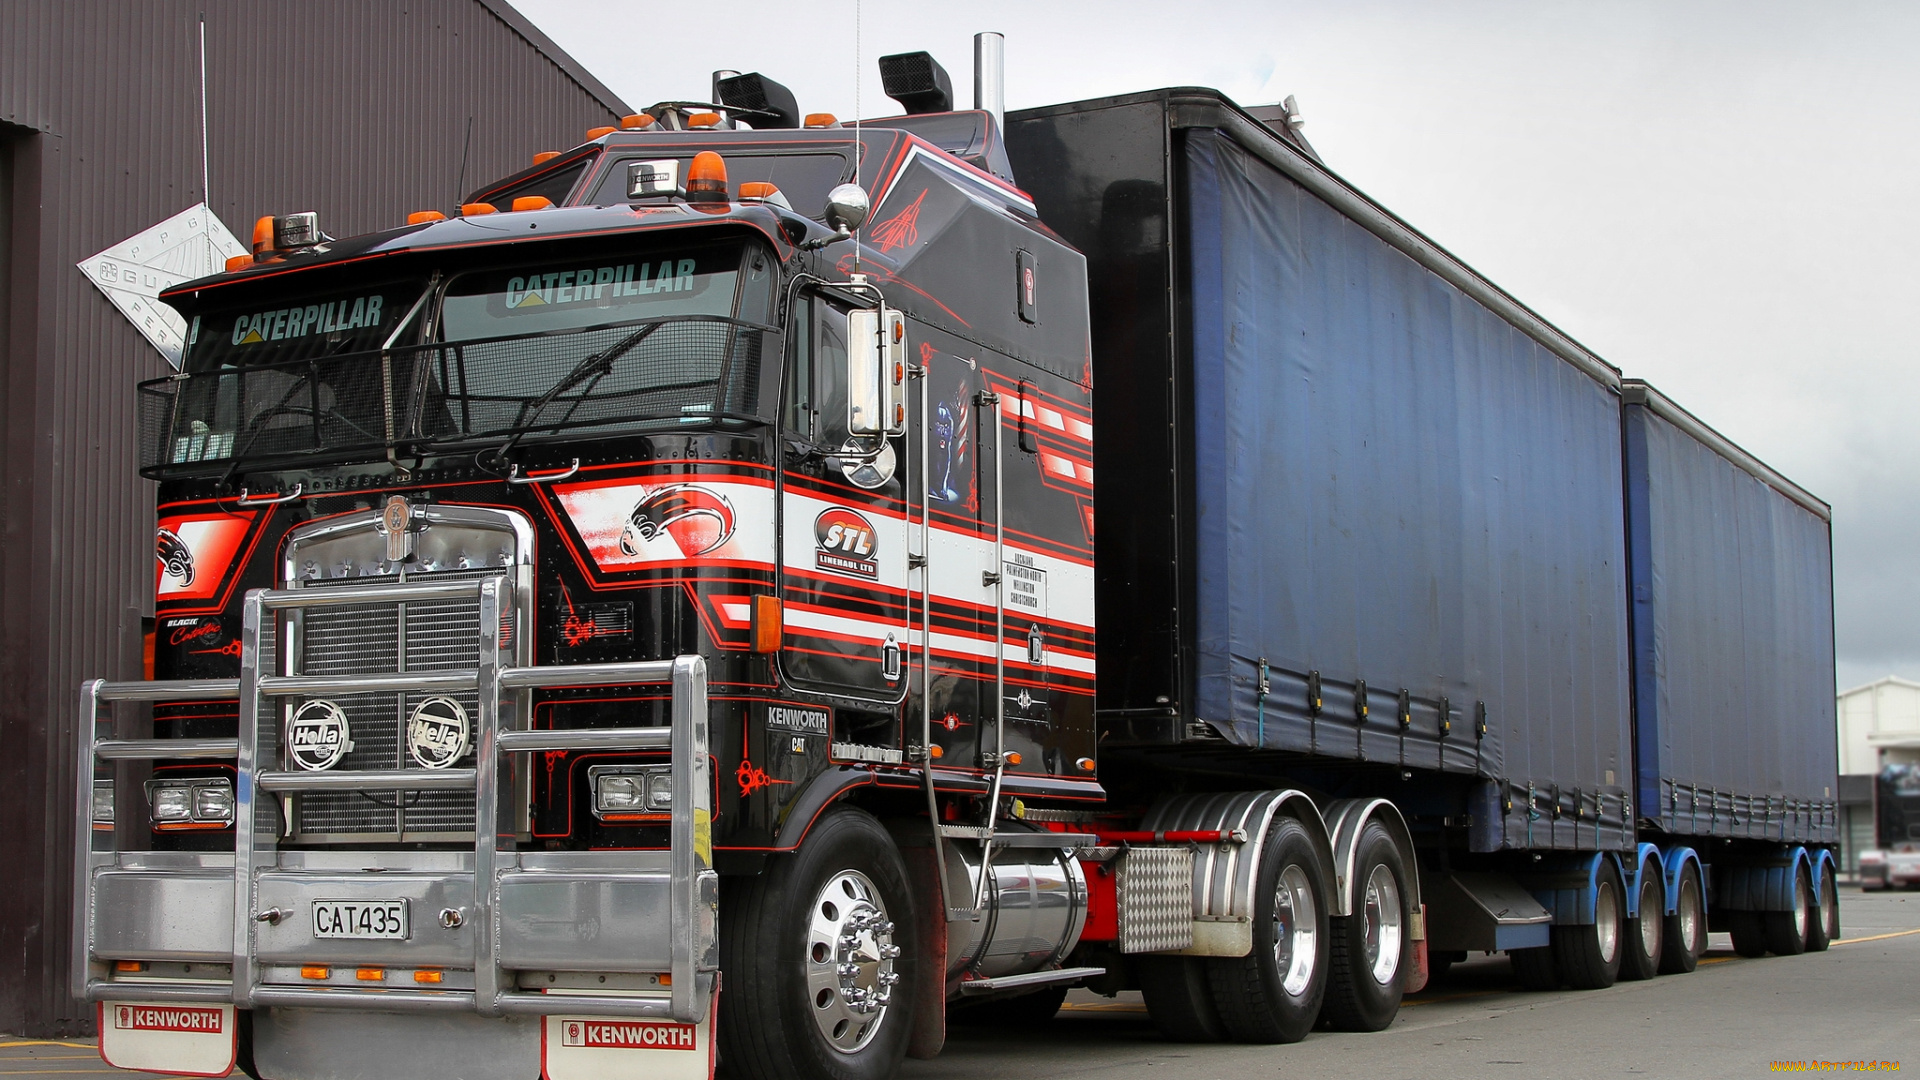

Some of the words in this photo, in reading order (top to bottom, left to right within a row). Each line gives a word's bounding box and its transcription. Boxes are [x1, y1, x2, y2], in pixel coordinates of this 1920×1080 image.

[505, 258, 696, 309] CATERPILLAR
[232, 295, 384, 346] CATERPILLAR
[823, 522, 871, 555] STL
[820, 554, 859, 570] LINEHAUL
[860, 563, 875, 573] LTD
[1006, 563, 1029, 580] PALMERSTON
[1030, 569, 1042, 582] NORTH
[1013, 579, 1035, 594] WELLINGTON
[1010, 592, 1038, 608] CHRISTCHURCH
[167, 618, 199, 627] BLACK
[768, 706, 827, 729] KENWORTH
[791, 737, 805, 752] CAT
[316, 906, 401, 933] CAT435
[136, 1010, 219, 1029] KENWORTH
[588, 1025, 692, 1046] KENWORTH
